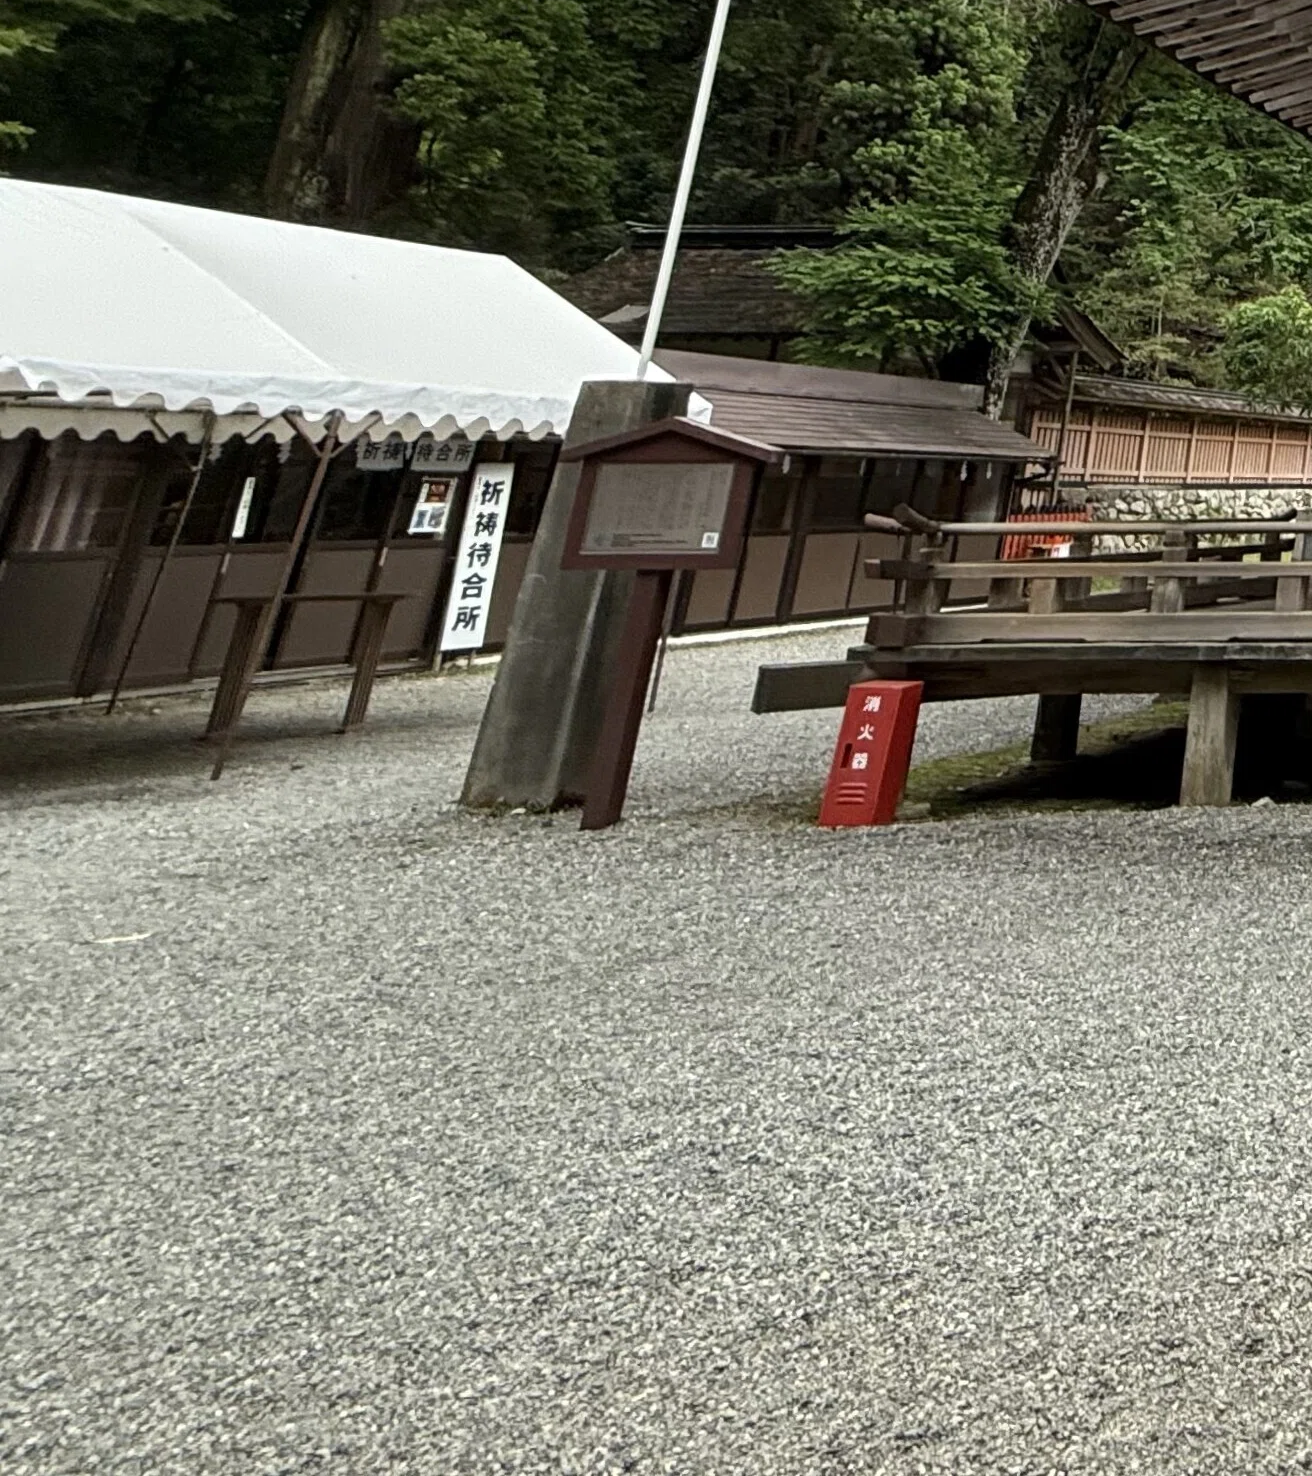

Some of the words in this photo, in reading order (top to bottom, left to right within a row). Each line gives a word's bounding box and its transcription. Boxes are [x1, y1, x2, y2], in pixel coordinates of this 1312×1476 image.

[451, 479, 505, 632] 祈祷待合所
[851, 695, 882, 770] 消火器
